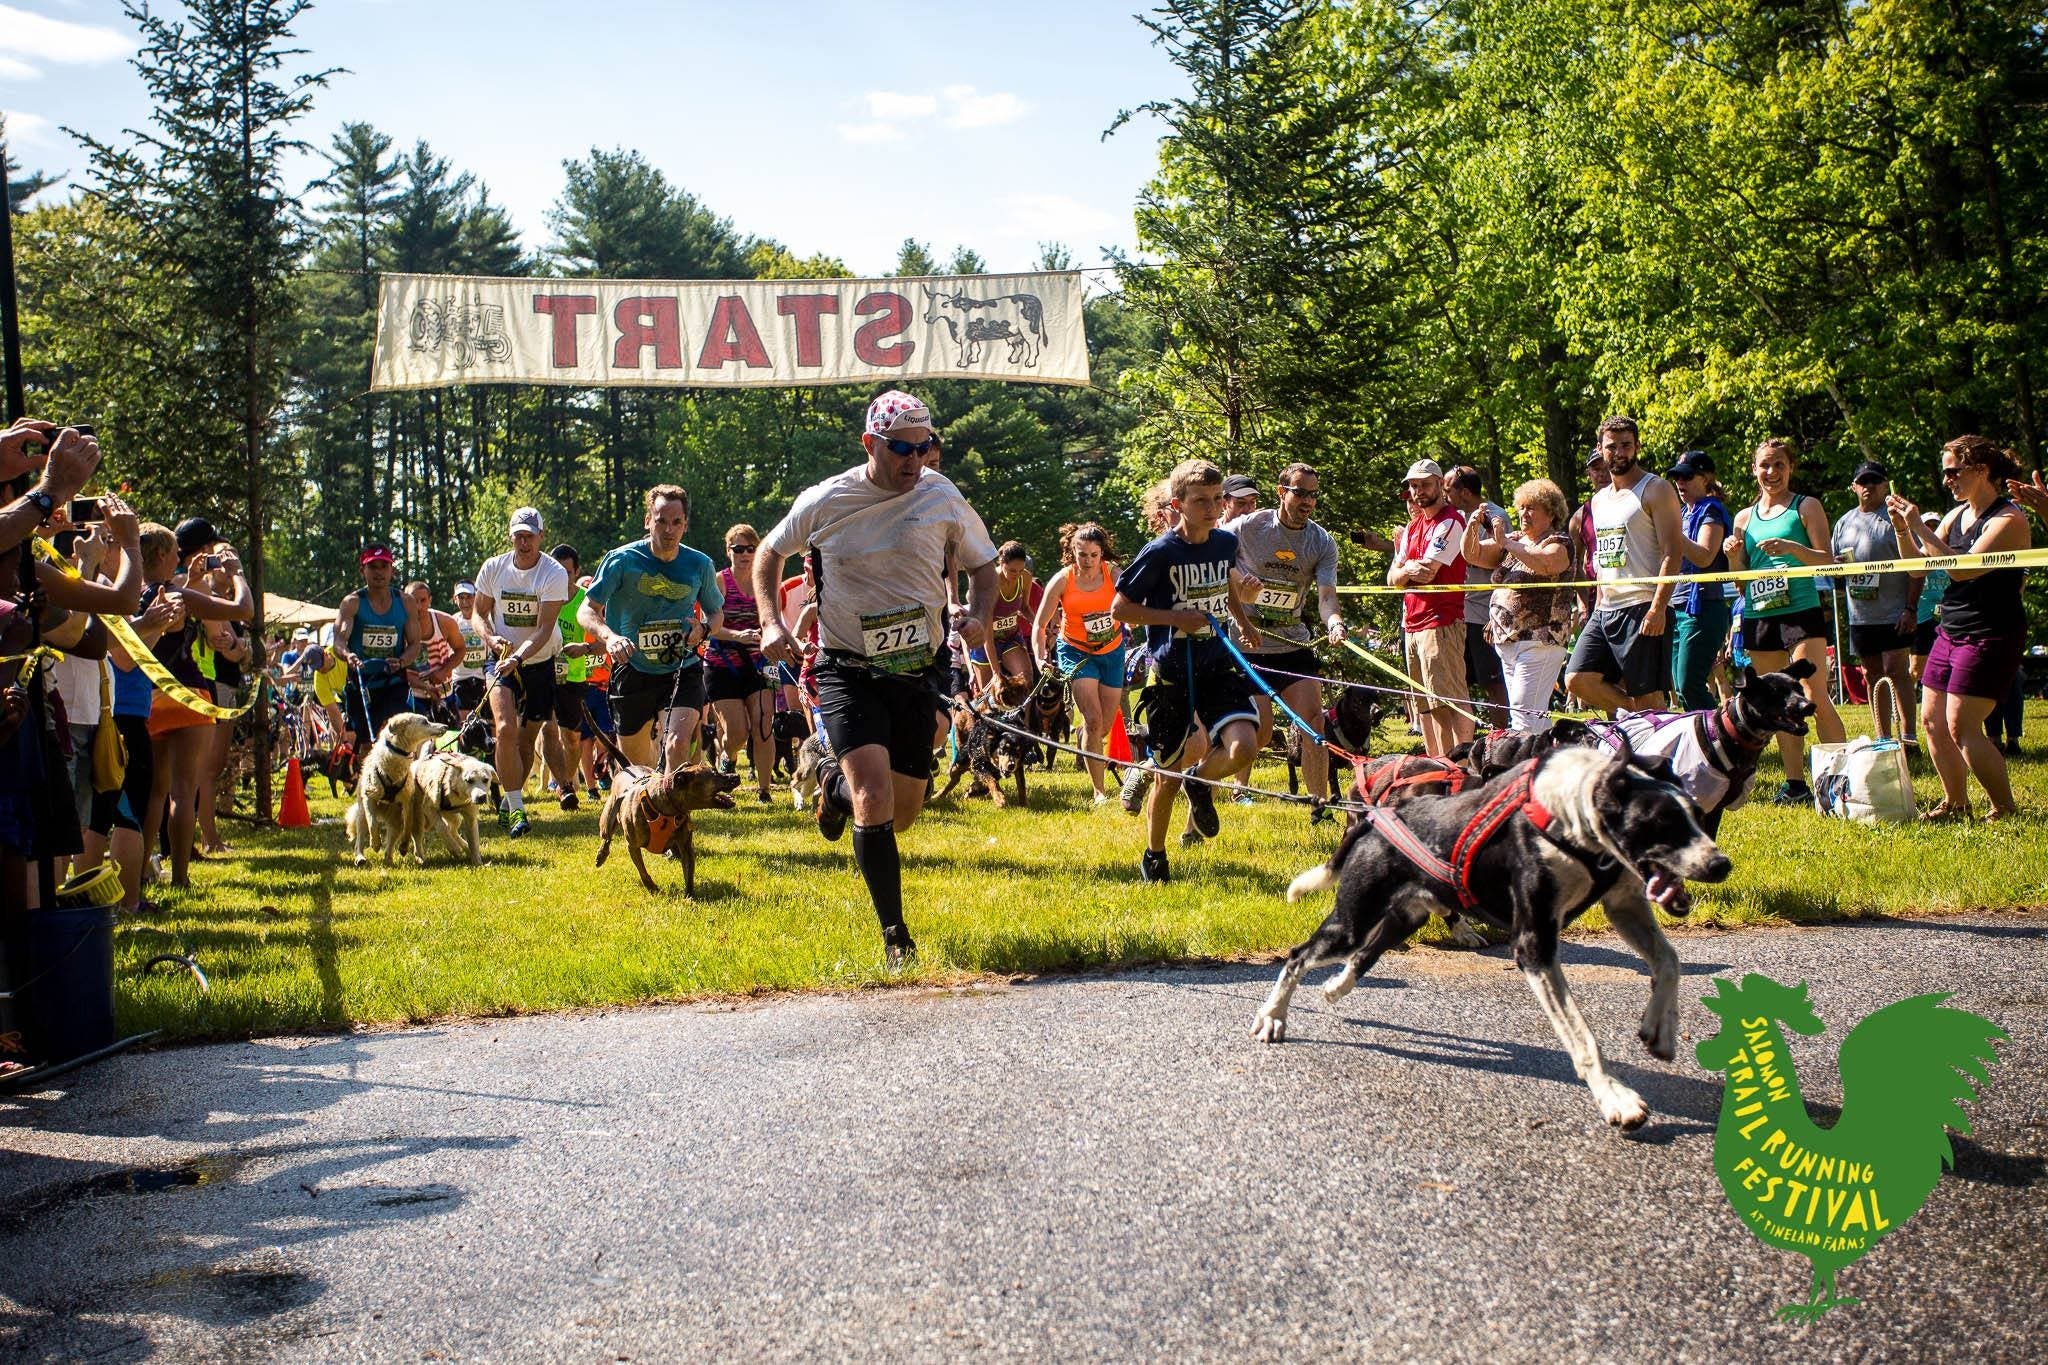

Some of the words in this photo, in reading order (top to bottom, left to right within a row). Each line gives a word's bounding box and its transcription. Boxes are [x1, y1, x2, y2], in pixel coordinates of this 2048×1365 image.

[1598, 537, 1624, 551] 1057
[1751, 576, 1786, 596] 1058
[1851, 574, 1873, 585] 497
[1262, 590, 1291, 606] 377
[507, 602, 532, 613] 814
[997, 617, 1014, 629] 845
[1091, 617, 1112, 631] 413
[368, 635, 393, 646] 753
[875, 624, 919, 652] 272
[466, 652, 482, 661] 745
